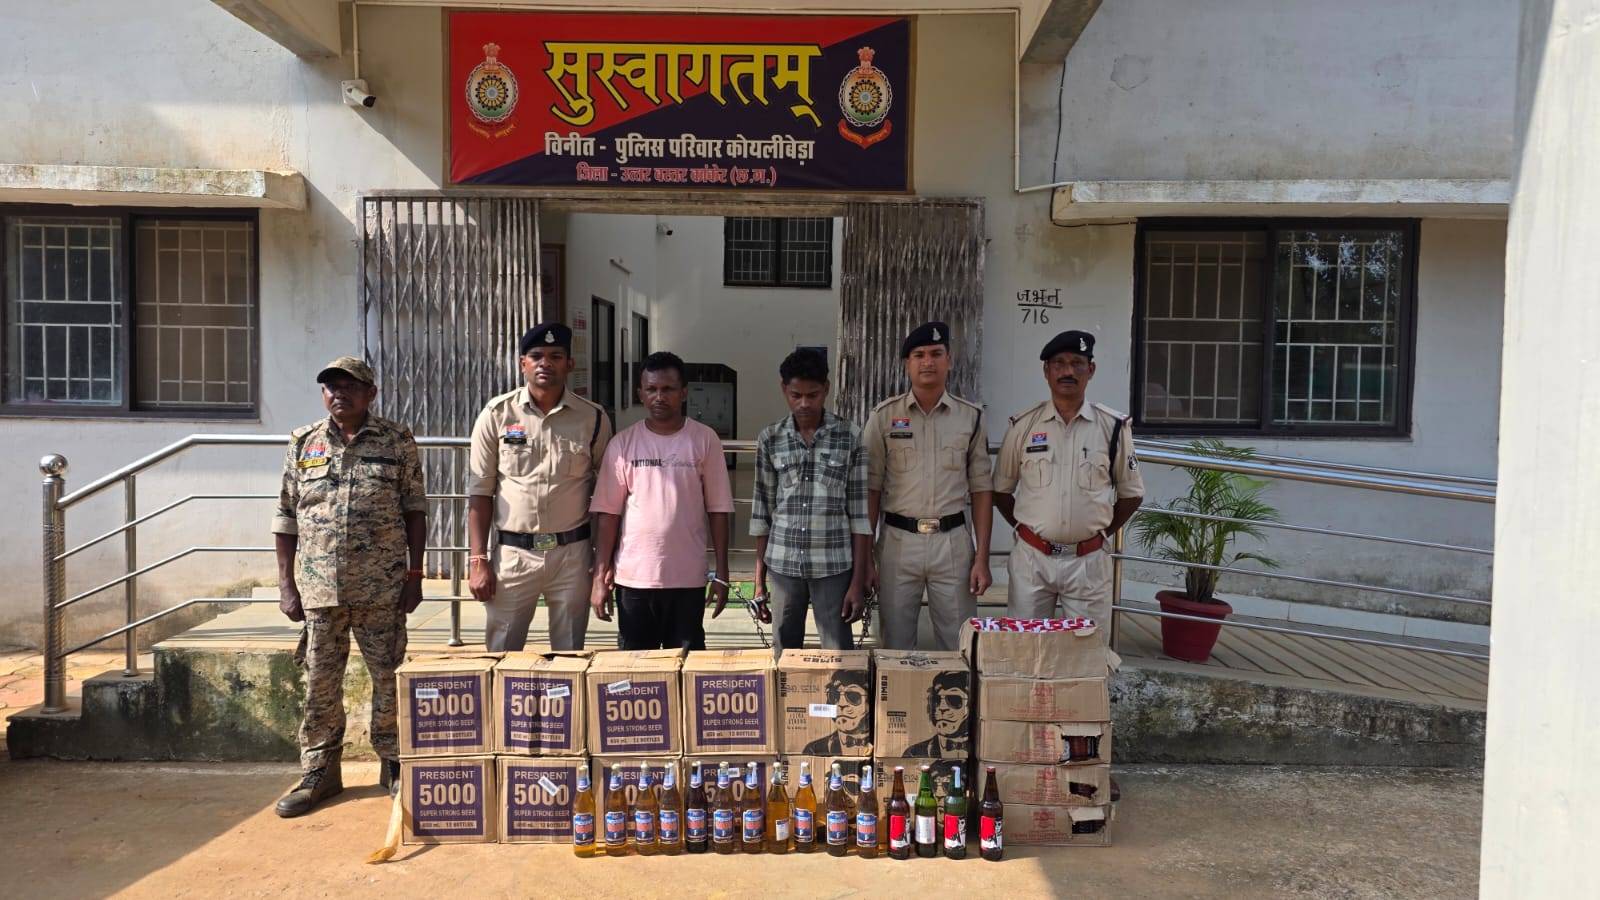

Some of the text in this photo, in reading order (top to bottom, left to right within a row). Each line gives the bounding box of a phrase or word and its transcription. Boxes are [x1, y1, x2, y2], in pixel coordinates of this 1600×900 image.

[543, 41, 824, 127] सुस्वागतम्
[544, 132, 595, 156] विनीत
[615, 133, 665, 164] पुलिस
[668, 134, 722, 158] परिवार
[725, 134, 815, 165] कोयलीबेड़ा
[576, 161, 608, 181] जिला
[620, 167, 651, 183] उत्तर
[654, 168, 687, 183] बस्तर
[690, 164, 727, 183] कांकेर
[1022, 309, 1049, 324] 716
[703, 680, 757, 688] PRESIDENT
[418, 694, 474, 716] 5000
[511, 695, 564, 717] 5000
[606, 699, 661, 721] 5000
[703, 692, 758, 714] 5000
[420, 771, 475, 780] PRESIDENT
[420, 783, 475, 805] 5000
[514, 784, 569, 806] 5000
